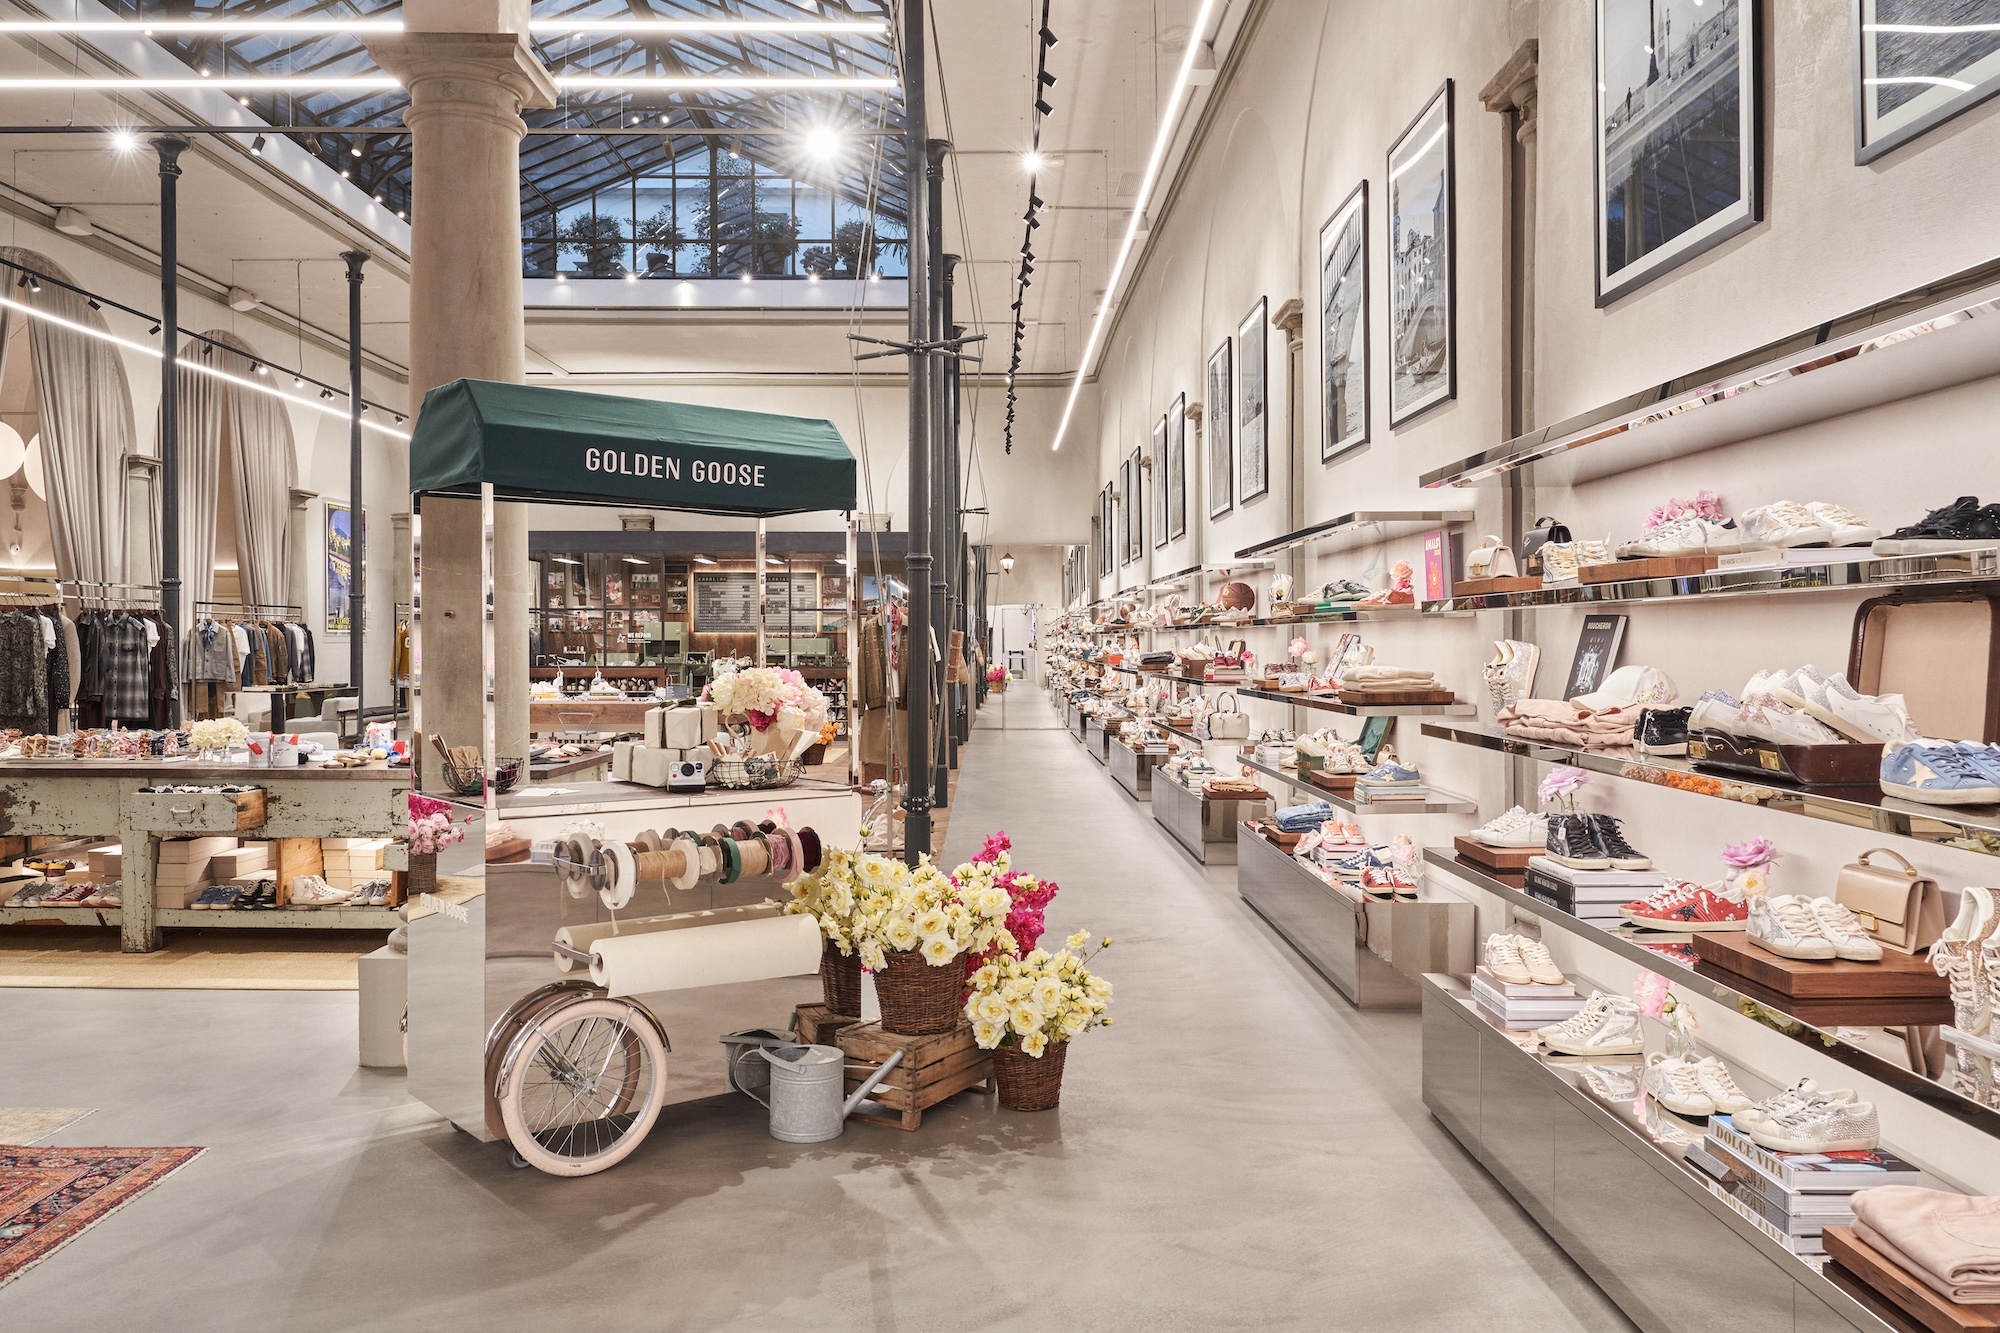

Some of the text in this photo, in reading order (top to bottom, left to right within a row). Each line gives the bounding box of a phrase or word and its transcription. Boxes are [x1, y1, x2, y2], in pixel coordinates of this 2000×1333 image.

[585, 447, 766, 487] GOLDEN GOOSE
[1716, 1125, 1754, 1160] DOLCE
[1756, 1150, 1784, 1180] VITA
